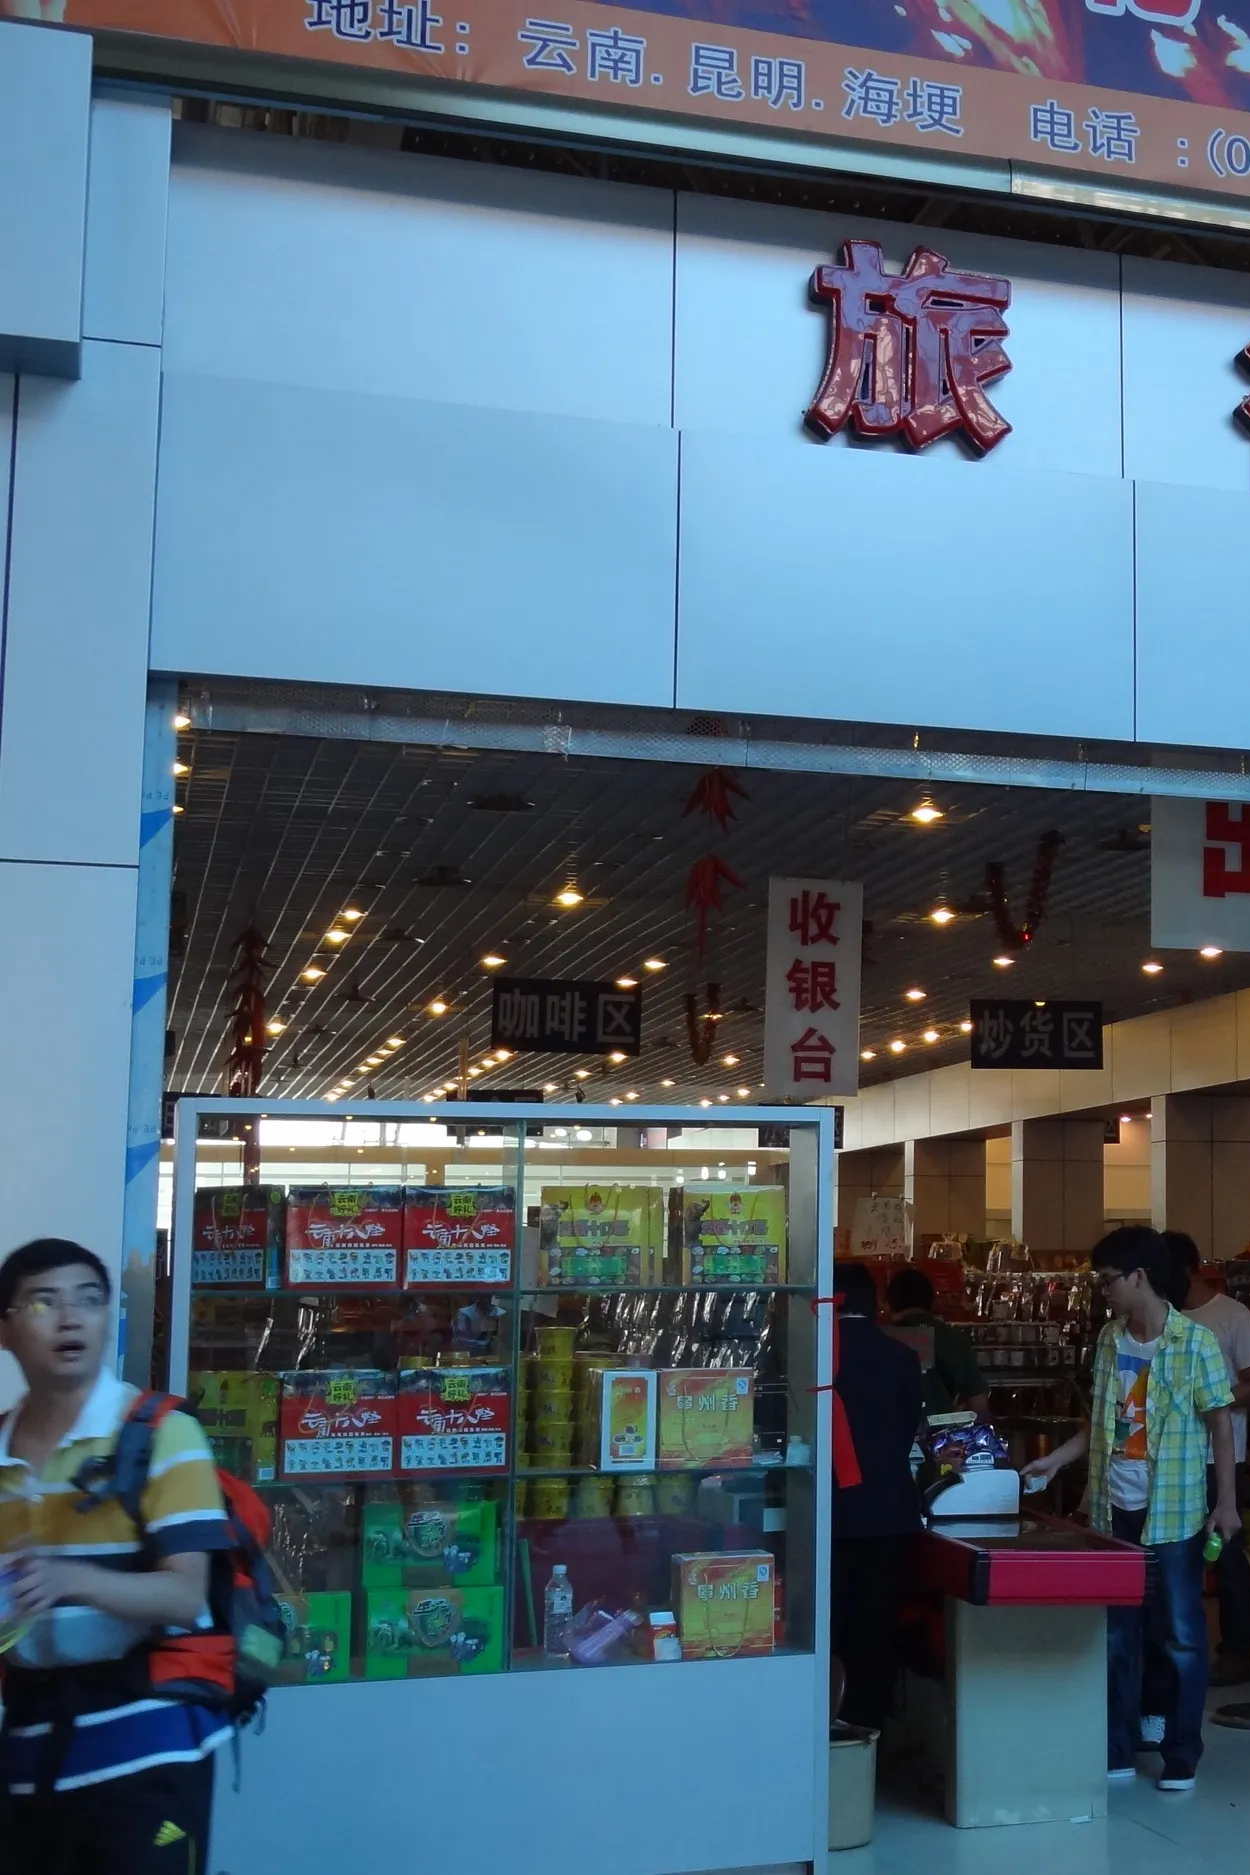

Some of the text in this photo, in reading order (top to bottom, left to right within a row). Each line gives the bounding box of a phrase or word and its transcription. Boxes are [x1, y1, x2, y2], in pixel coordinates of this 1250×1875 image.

[1029, 98, 1140, 165] 电话
[498, 988, 636, 1044] 咖啡区
[785, 889, 842, 1085] 收银台
[978, 1008, 1097, 1060] 炒货区
